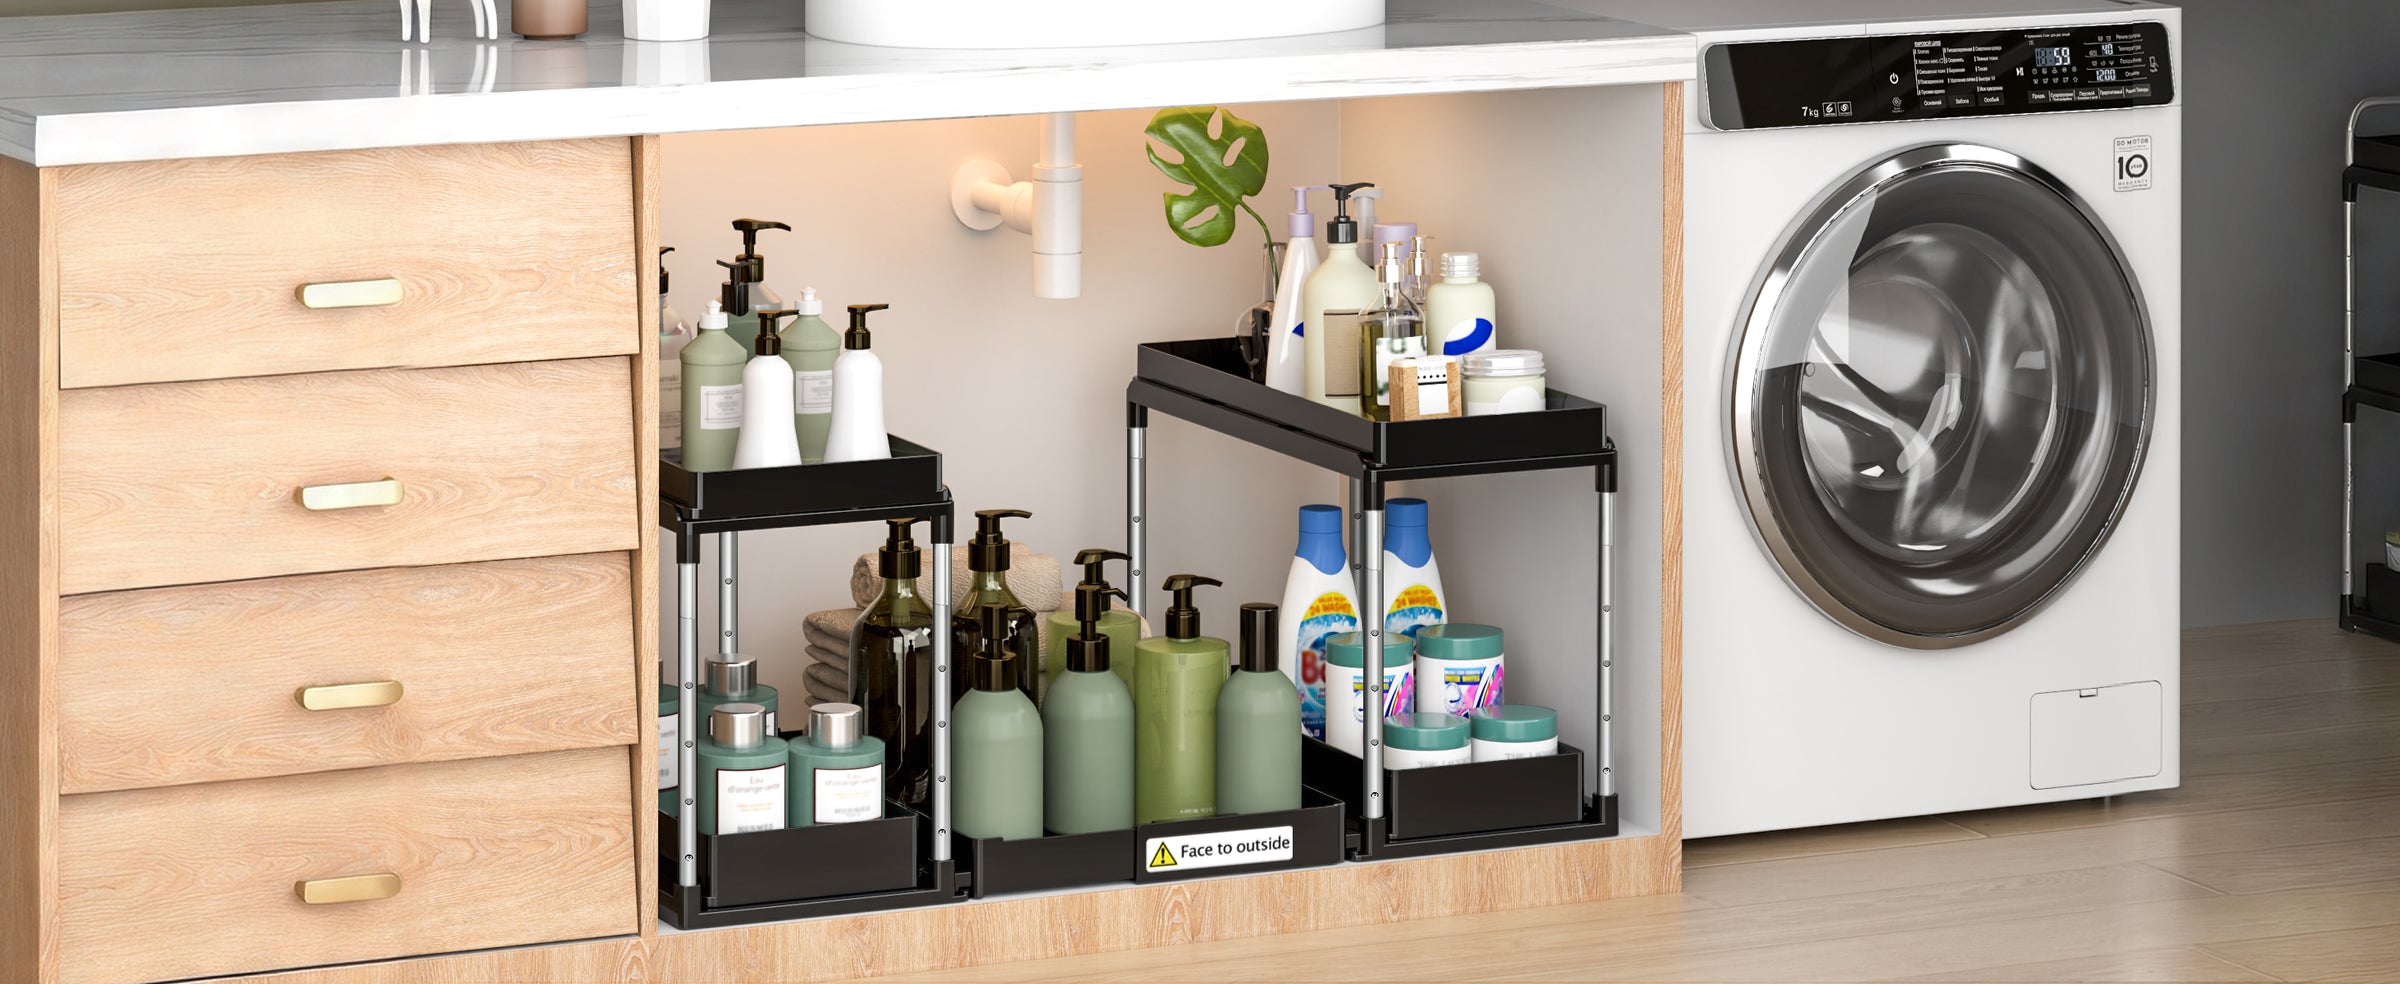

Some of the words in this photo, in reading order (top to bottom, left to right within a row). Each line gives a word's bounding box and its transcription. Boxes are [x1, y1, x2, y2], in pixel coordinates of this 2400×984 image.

[2054, 47, 2070, 66] 59
[2102, 44, 2113, 56] 40
[2096, 70, 2116, 80] 1200
[2118, 154, 2148, 180] 10
[1181, 844, 1213, 859] Face
[1218, 843, 1232, 856] to
[1236, 835, 1290, 854] outside
